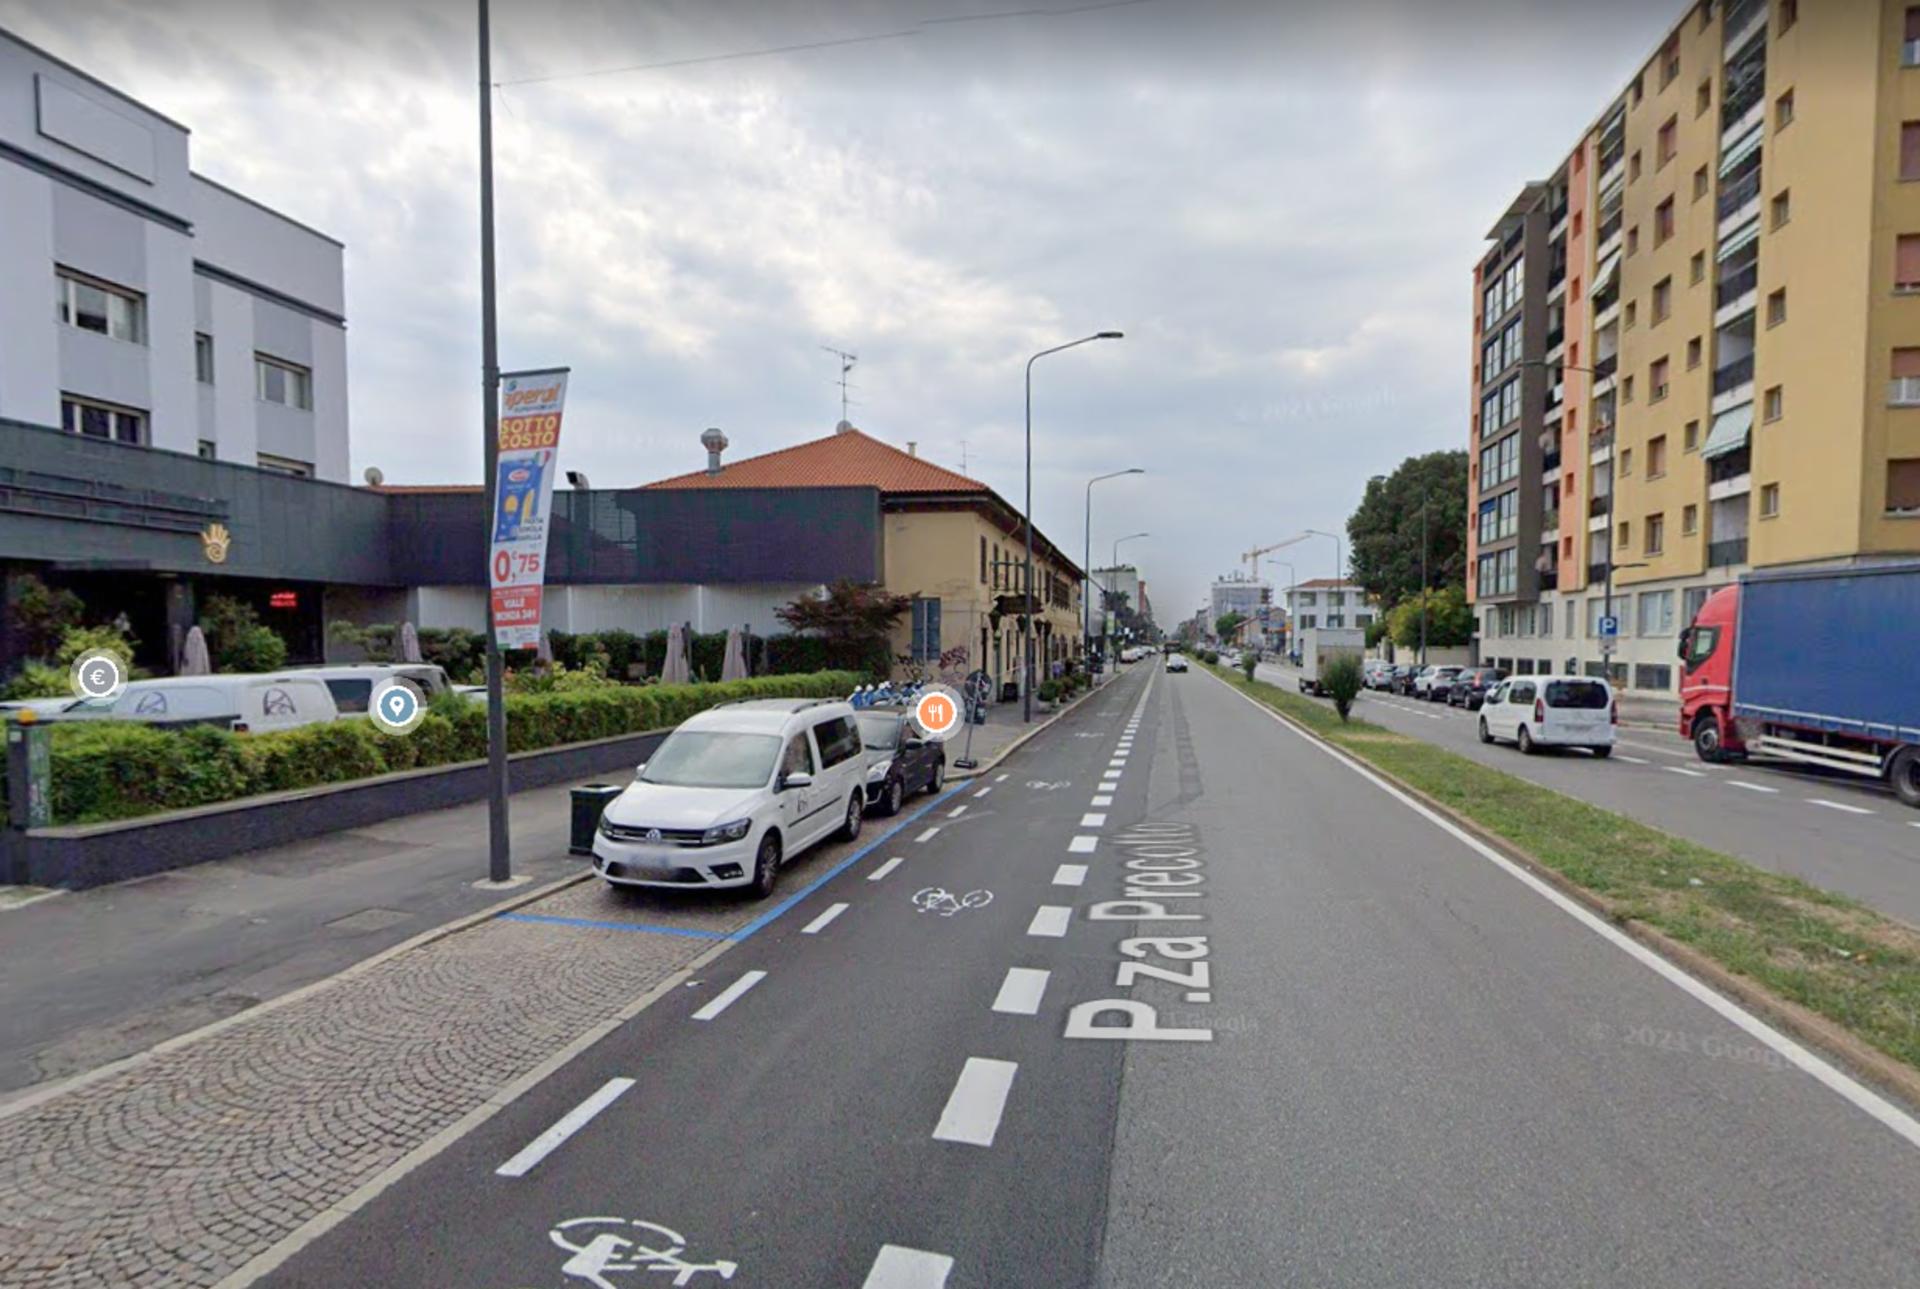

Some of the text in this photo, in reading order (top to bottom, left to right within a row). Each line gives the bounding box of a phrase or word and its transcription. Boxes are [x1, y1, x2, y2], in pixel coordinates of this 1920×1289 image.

[500, 415, 557, 434] SOTTO
[498, 430, 556, 450] COSTO
[1602, 617, 1615, 635] P
